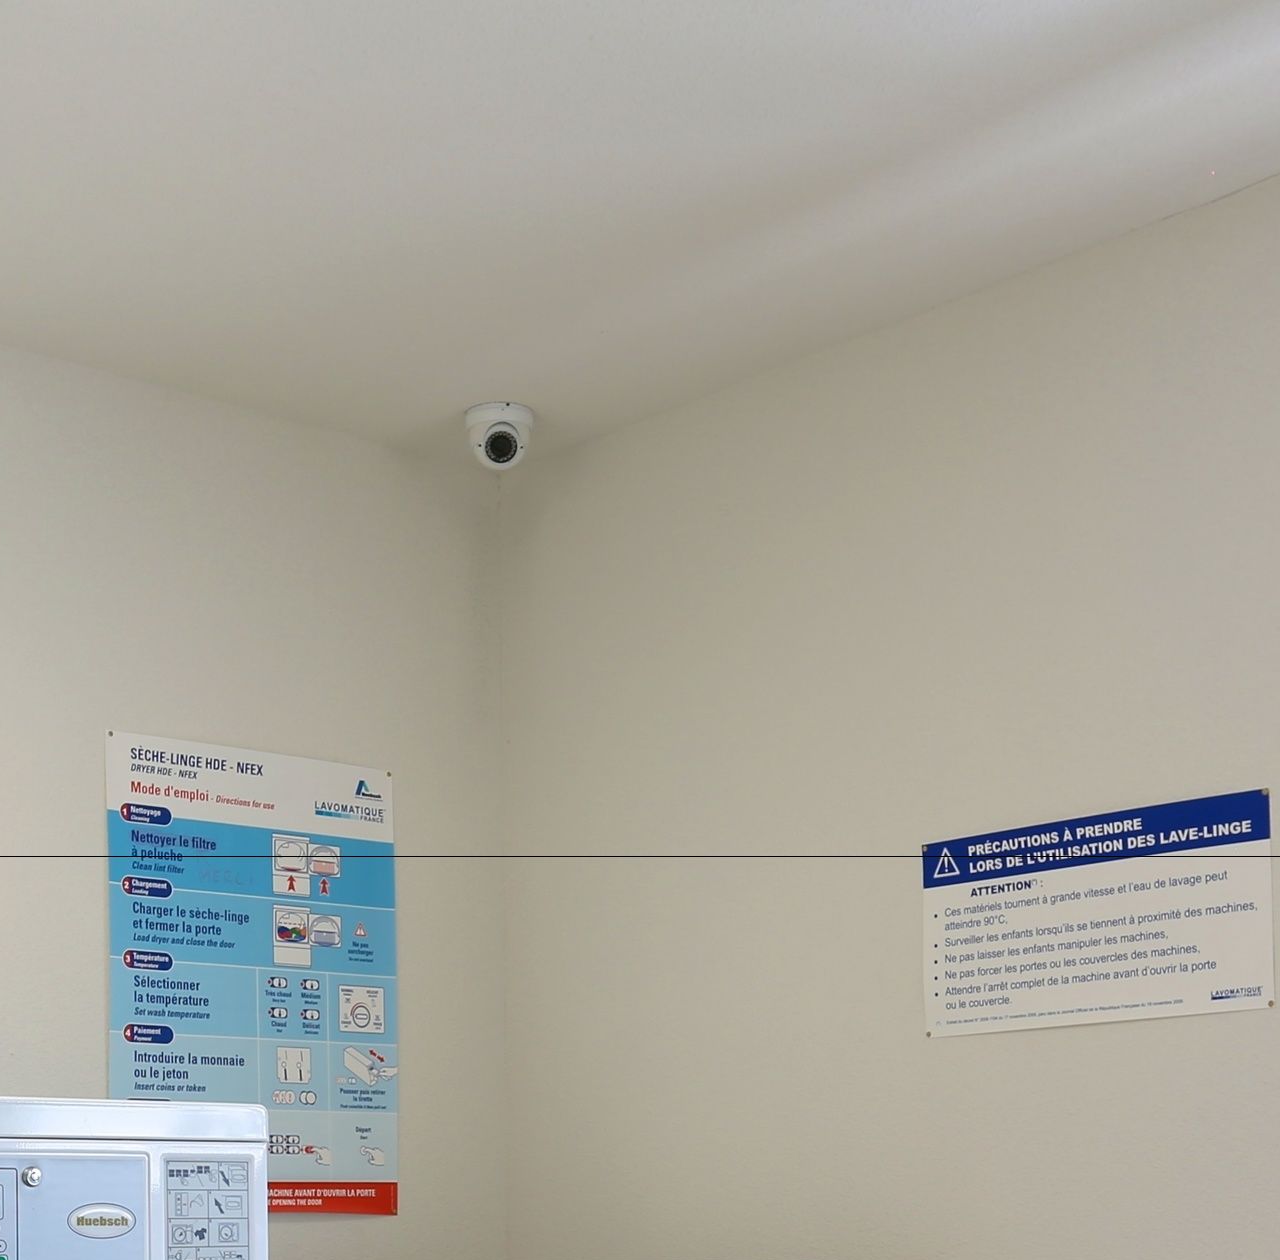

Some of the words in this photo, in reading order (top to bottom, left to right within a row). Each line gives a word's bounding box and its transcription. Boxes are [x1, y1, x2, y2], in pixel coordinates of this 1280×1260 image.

[130, 746, 202, 768] SÈCHE-LINGE
[205, 757, 227, 771] HDE
[236, 762, 263, 776] NFEX
[130, 763, 155, 775] DRYER
[157, 767, 172, 777] HDE
[178, 769, 198, 779] NFEX
[131, 781, 161, 795] Mode
[164, 785, 209, 803] d'emploi
[968, 831, 1059, 857] PRÉCAUTIONS
[1063, 827, 1073, 842] À
[1076, 818, 1142, 840] PRENDRE
[969, 857, 1003, 874] LORS
[1006, 855, 1024, 868] DE
[1027, 839, 1123, 865] L'UTILISATION
[1127, 834, 1155, 850] DES
[1159, 820, 1252, 845] LAVE-LINGE
[132, 901, 173, 918] Charger
[176, 905, 186, 918] le
[189, 907, 250, 925] sèche-linge
[944, 934, 984, 948] Surveiller
[986, 933, 999, 942] les
[1001, 928, 1033, 941] enfants
[1035, 923, 1075, 938] lorsqu'ils
[1076, 922, 1088, 931] se
[1090, 916, 1126, 930] tiennent
[1137, 909, 1181, 926] proximité
[1184, 906, 1202, 919] des
[133, 975, 200, 991] Sélectionner
[133, 990, 143, 1003] la
[146, 992, 209, 1007] température
[945, 1000, 957, 1010] ou
[959, 998, 967, 1009] le
[134, 1050, 185, 1065] Introduire
[188, 1053, 197, 1065] la
[200, 1055, 245, 1067] monnaie
[76, 1216, 129, 1227] Huebsch
